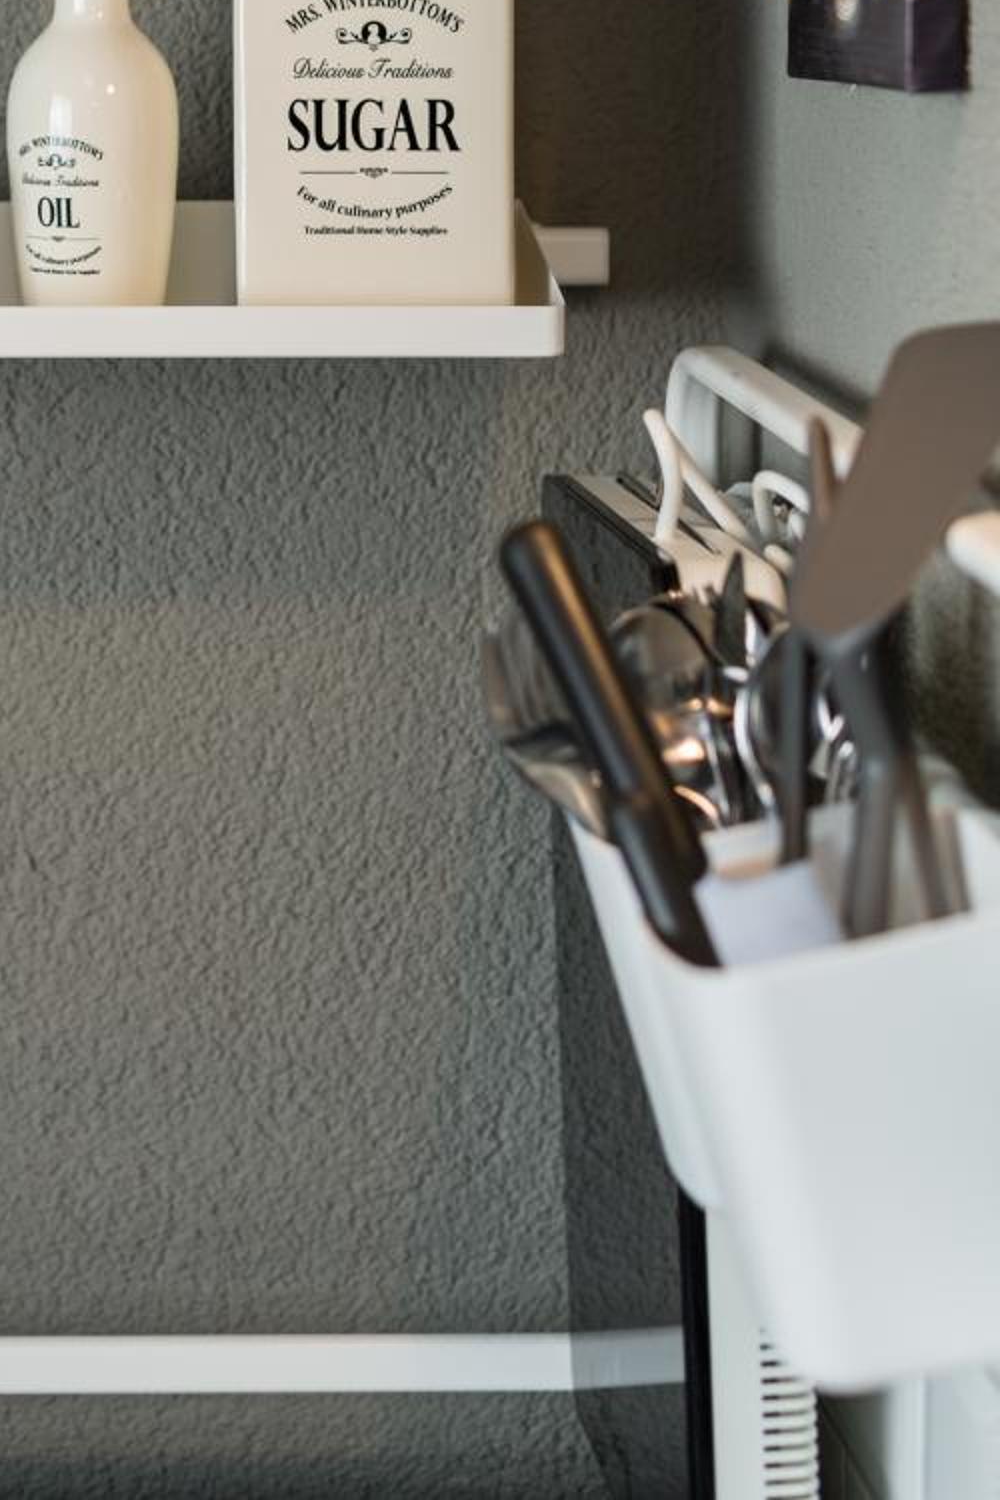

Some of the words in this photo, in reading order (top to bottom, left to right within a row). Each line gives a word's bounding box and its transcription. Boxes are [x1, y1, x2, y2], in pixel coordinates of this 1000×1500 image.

[285, 4, 323, 34] MRS.
[293, 56, 366, 79] Delicious
[367, 57, 454, 79] Traditions
[287, 98, 462, 152] SUGAR
[37, 196, 81, 229] OIL
[297, 185, 319, 205] For
[318, 199, 337, 213] all
[337, 204, 393, 220] culinary
[395, 185, 453, 219] purposes
